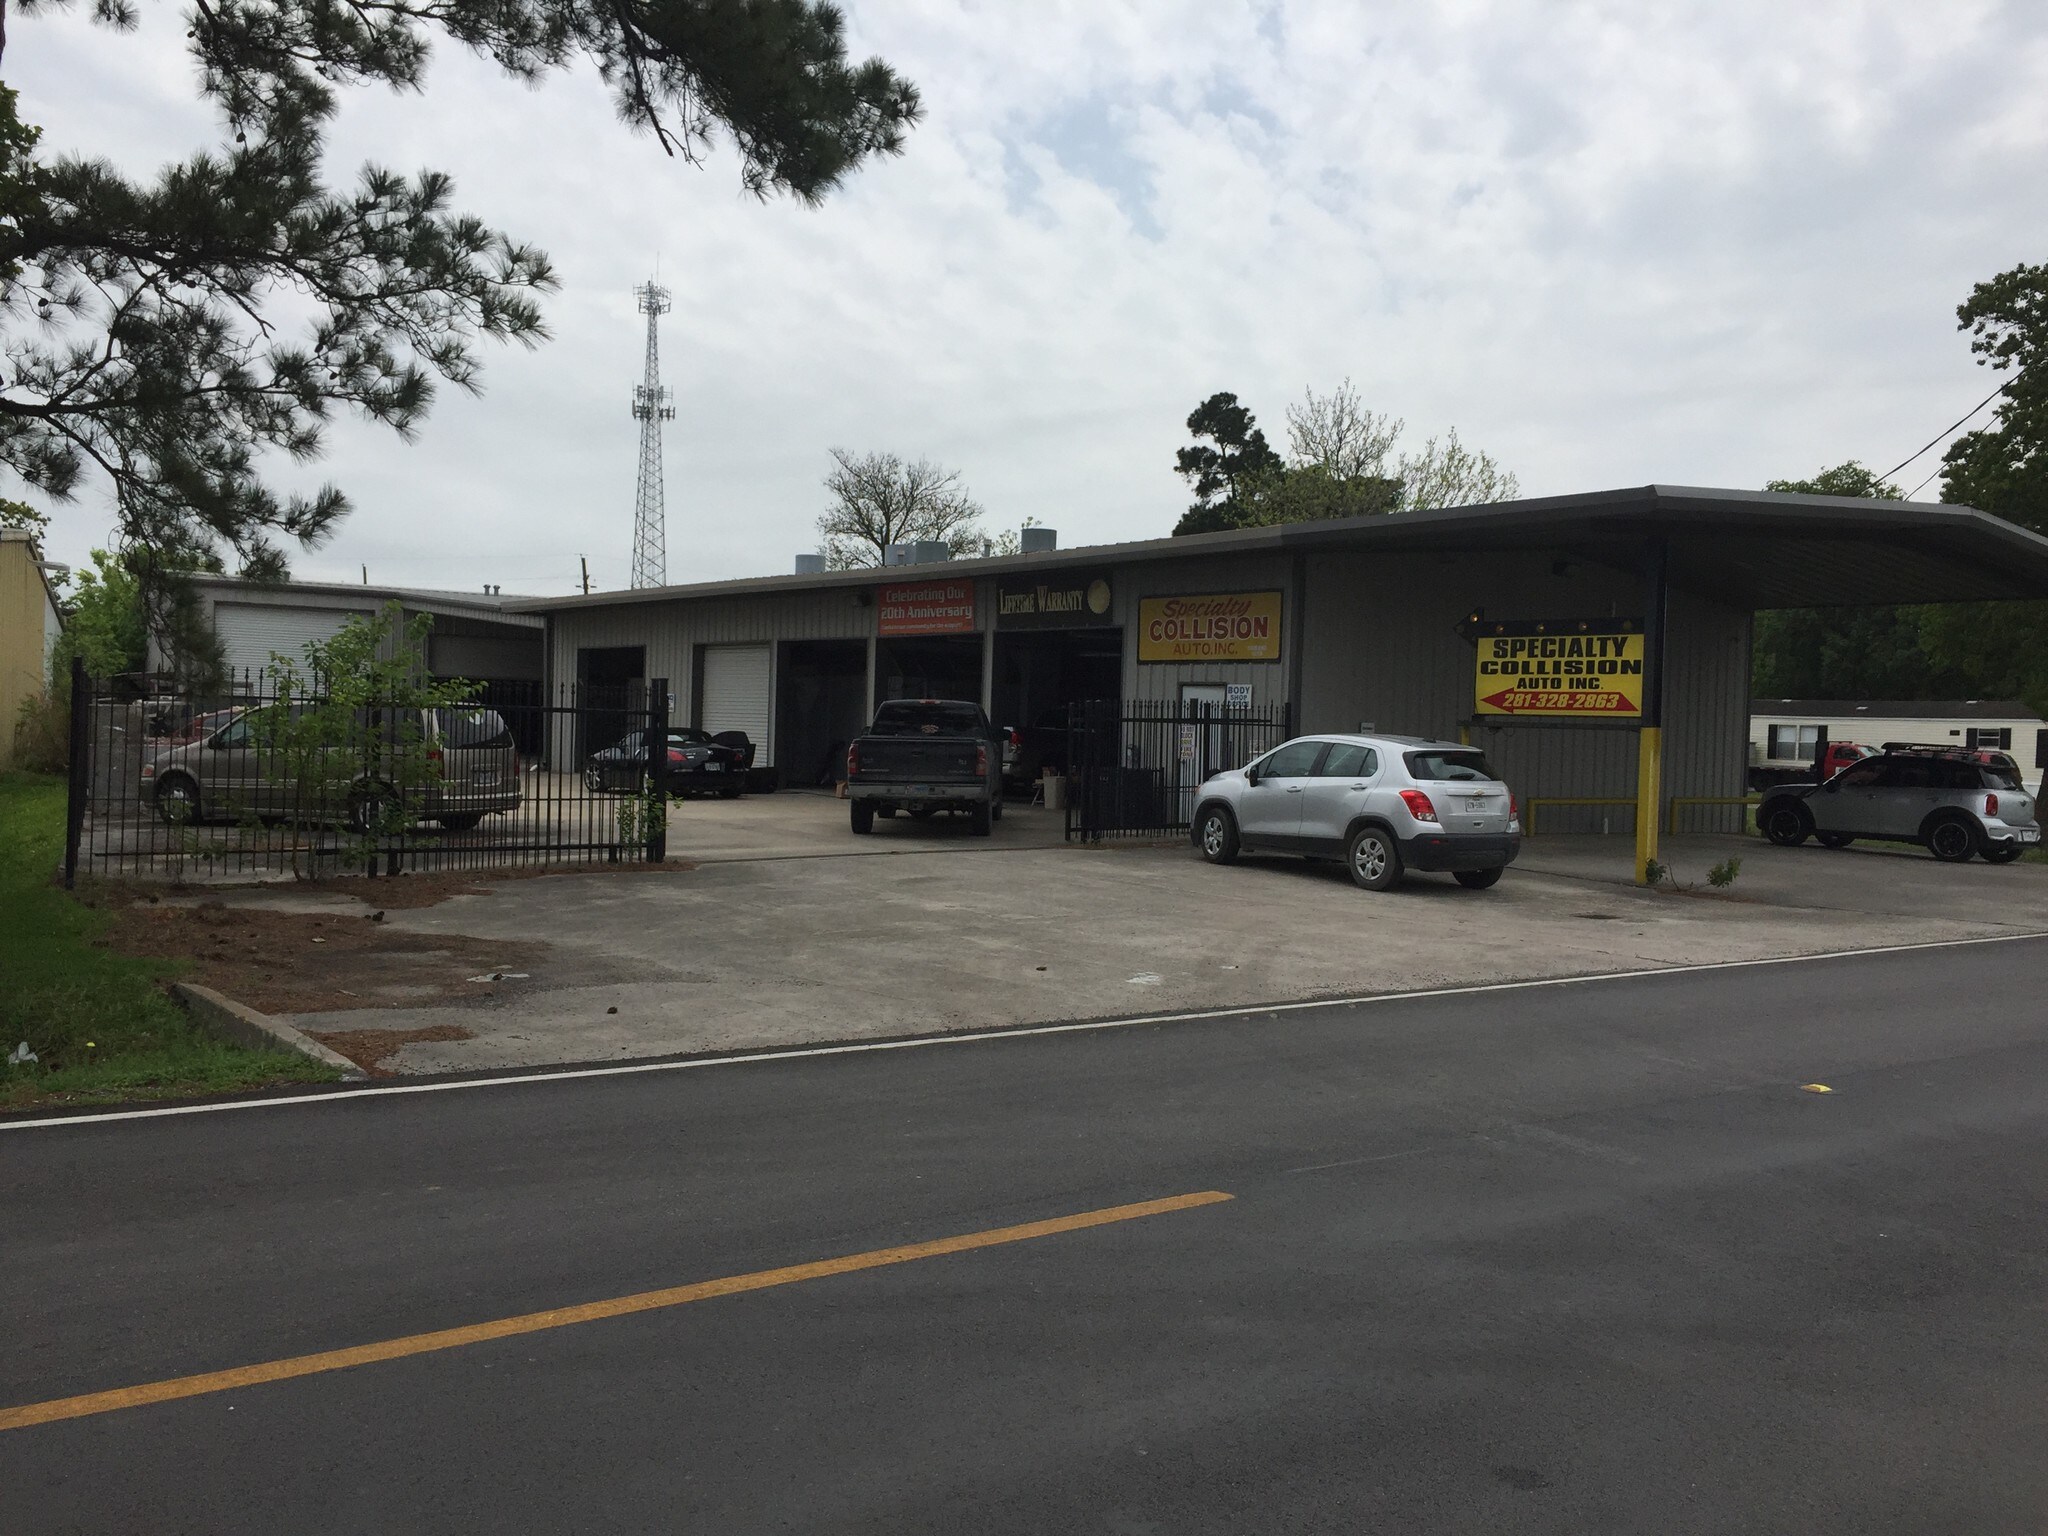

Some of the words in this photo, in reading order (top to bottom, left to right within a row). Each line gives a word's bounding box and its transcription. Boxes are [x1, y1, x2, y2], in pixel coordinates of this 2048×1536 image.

[886, 588, 945, 603] Celebrating
[946, 586, 965, 600] Our
[881, 606, 905, 620] 20th
[907, 605, 973, 620] Anniversary
[1162, 597, 1252, 619] Specialty
[1149, 615, 1270, 642] COLLISION
[1493, 636, 1629, 658] SPECIALTY
[1480, 659, 1642, 675] COLLISION
[1227, 686, 1250, 694] BODY
[1516, 677, 1562, 690] AUTO
[1568, 677, 1604, 690] INC.
[1502, 693, 1620, 709] 281-328-2863
